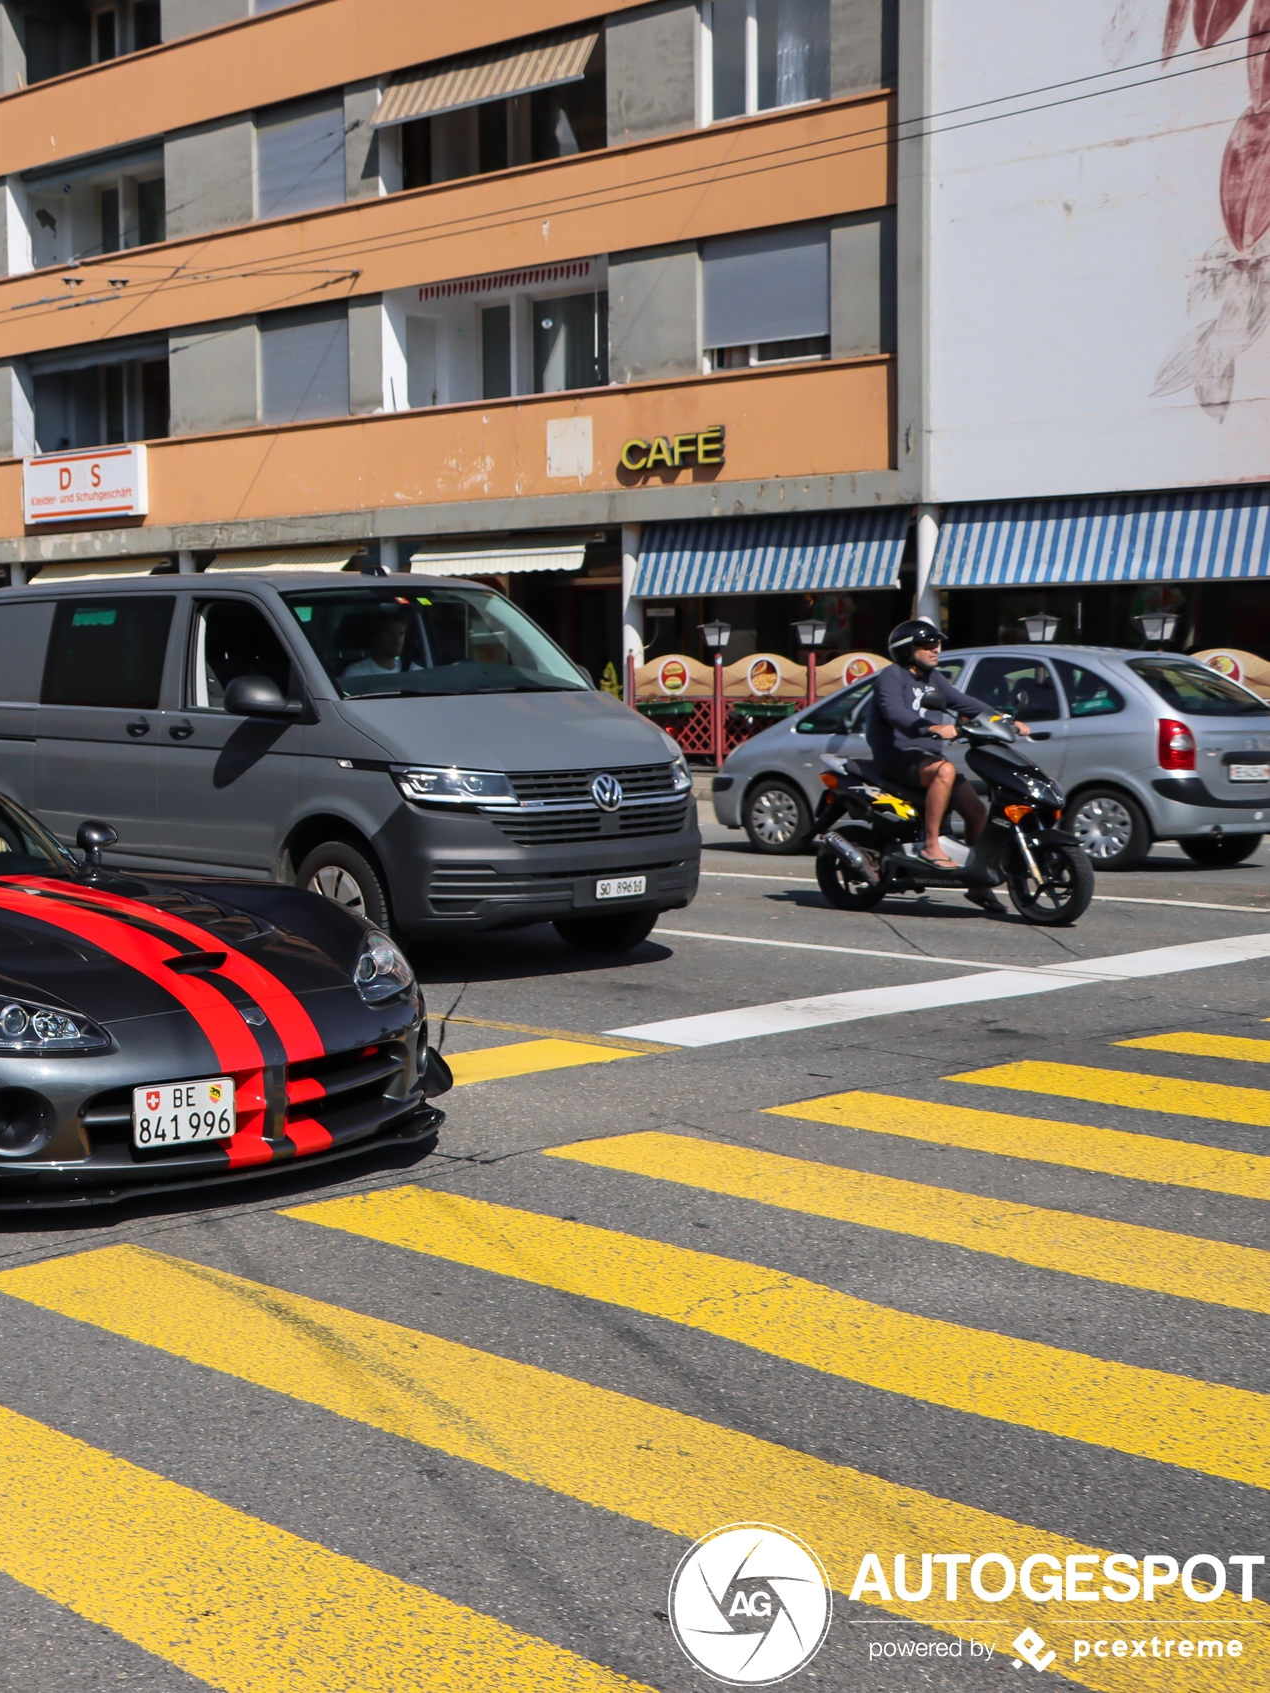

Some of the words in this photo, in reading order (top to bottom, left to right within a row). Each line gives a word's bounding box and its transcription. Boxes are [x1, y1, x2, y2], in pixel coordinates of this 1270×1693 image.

[621, 425, 724, 470] CAFÉ
[59, 467, 72, 491] D
[91, 463, 101, 488] S
[60, 491, 75, 504] und
[76, 487, 133, 503] Schuhgeschäft
[600, 882, 611, 896] SO
[173, 1086, 196, 1108] BE
